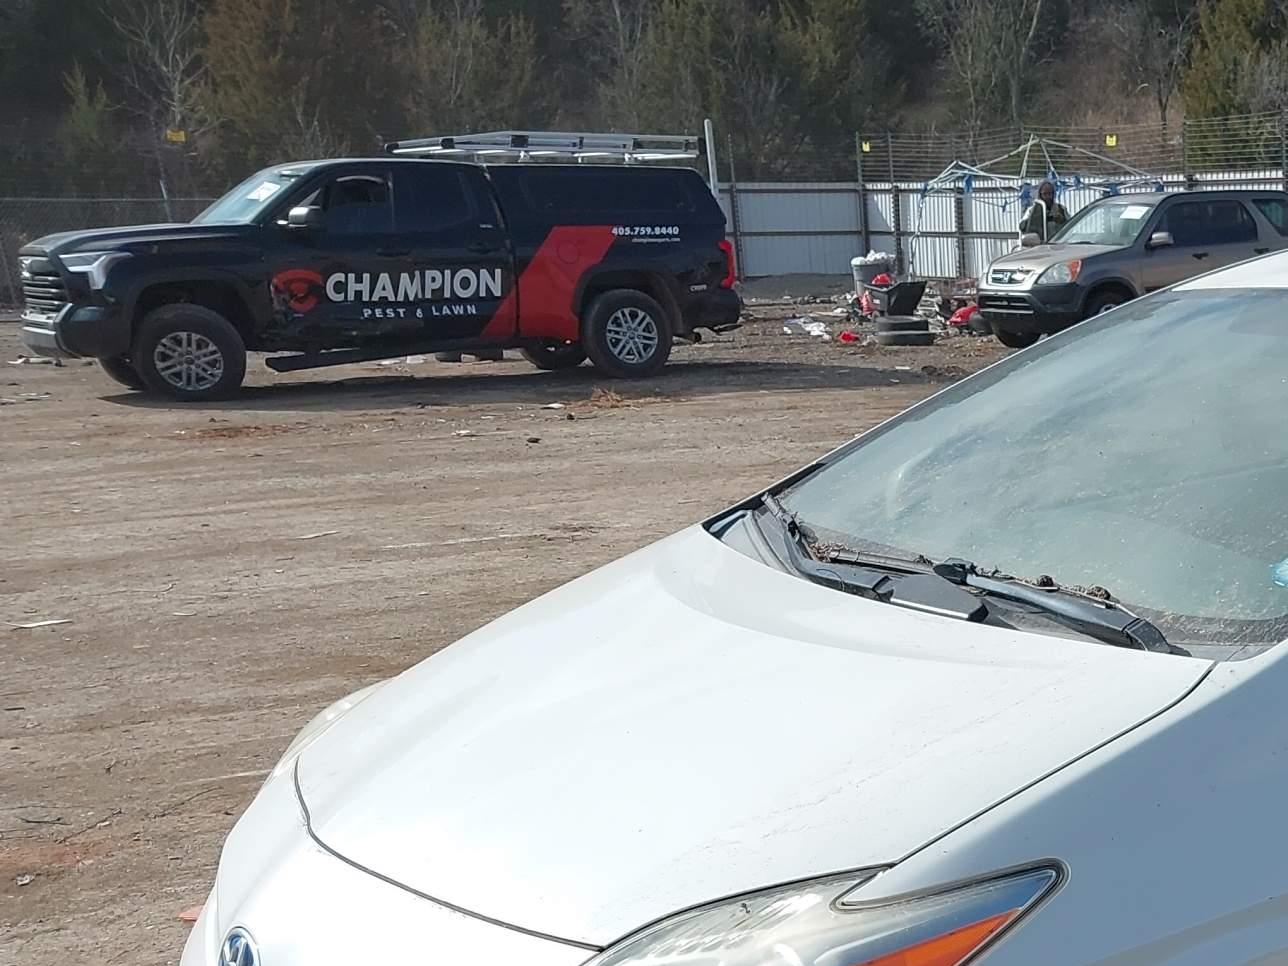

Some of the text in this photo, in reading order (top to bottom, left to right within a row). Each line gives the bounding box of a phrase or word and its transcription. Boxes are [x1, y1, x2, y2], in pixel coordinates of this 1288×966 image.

[325, 268, 502, 302] CHAMPION
[363, 304, 477, 318] PEST & LAWN
